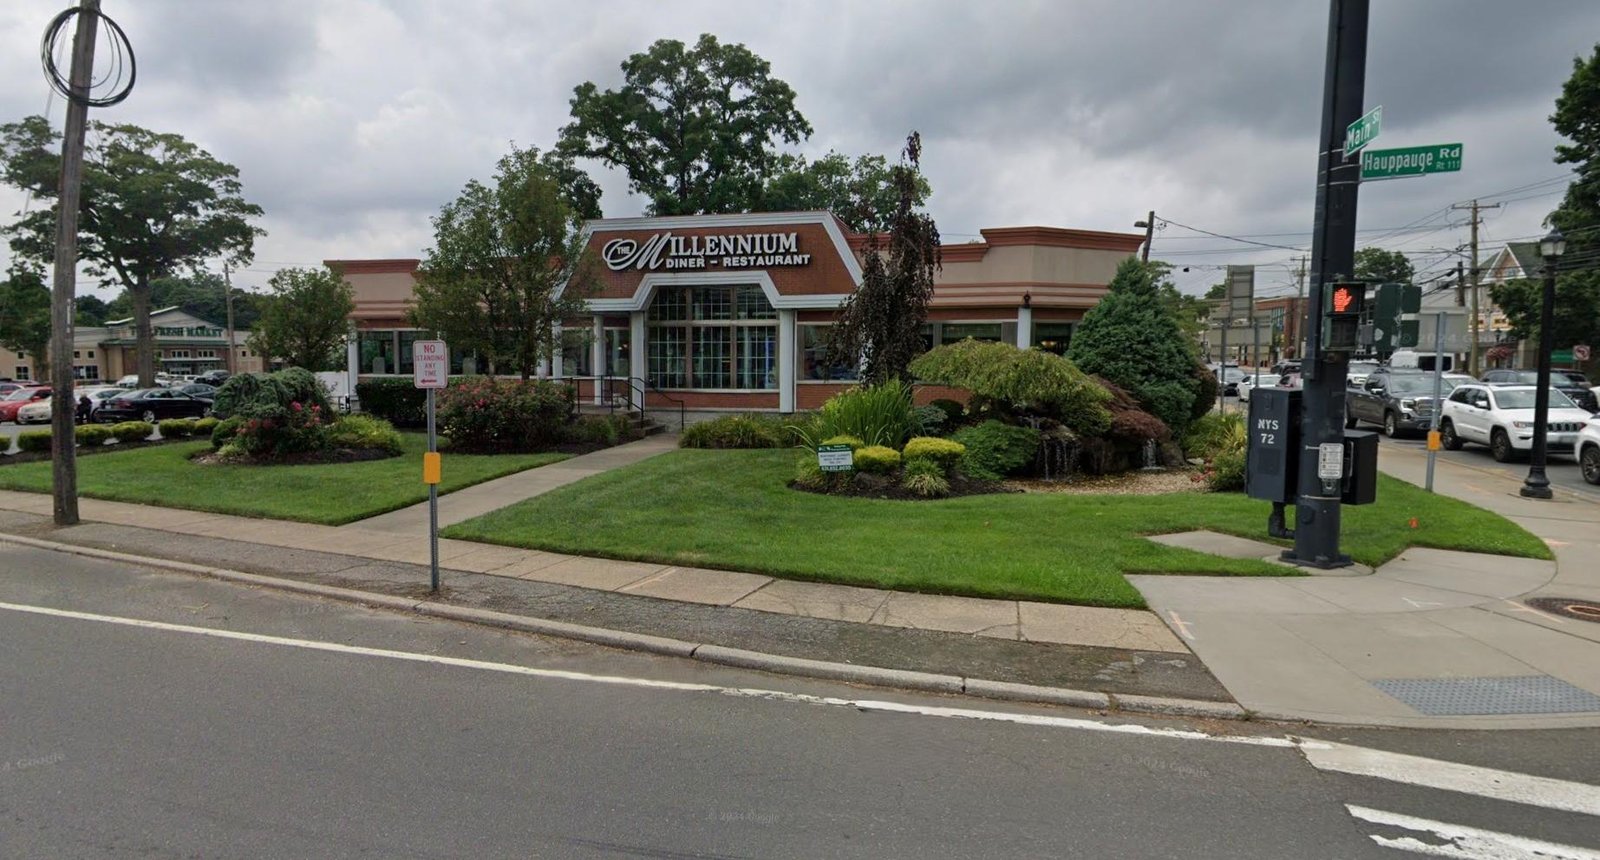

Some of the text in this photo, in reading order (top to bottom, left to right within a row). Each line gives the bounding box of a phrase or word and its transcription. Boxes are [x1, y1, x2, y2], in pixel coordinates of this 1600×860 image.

[1346, 111, 1380, 150] Main St
[1364, 147, 1460, 172] Hauppauge Rd
[1447, 160, 1461, 169] 111
[603, 232, 798, 270] MILLENNIUM
[617, 245, 631, 255] THE
[666, 258, 705, 269] DINER
[722, 254, 811, 268] RESTAURANT
[154, 326, 184, 336] FRESH
[186, 326, 223, 337] MARKET
[424, 344, 436, 354] NO
[1258, 419, 1279, 430] NYS
[1260, 433, 1275, 444] 72
